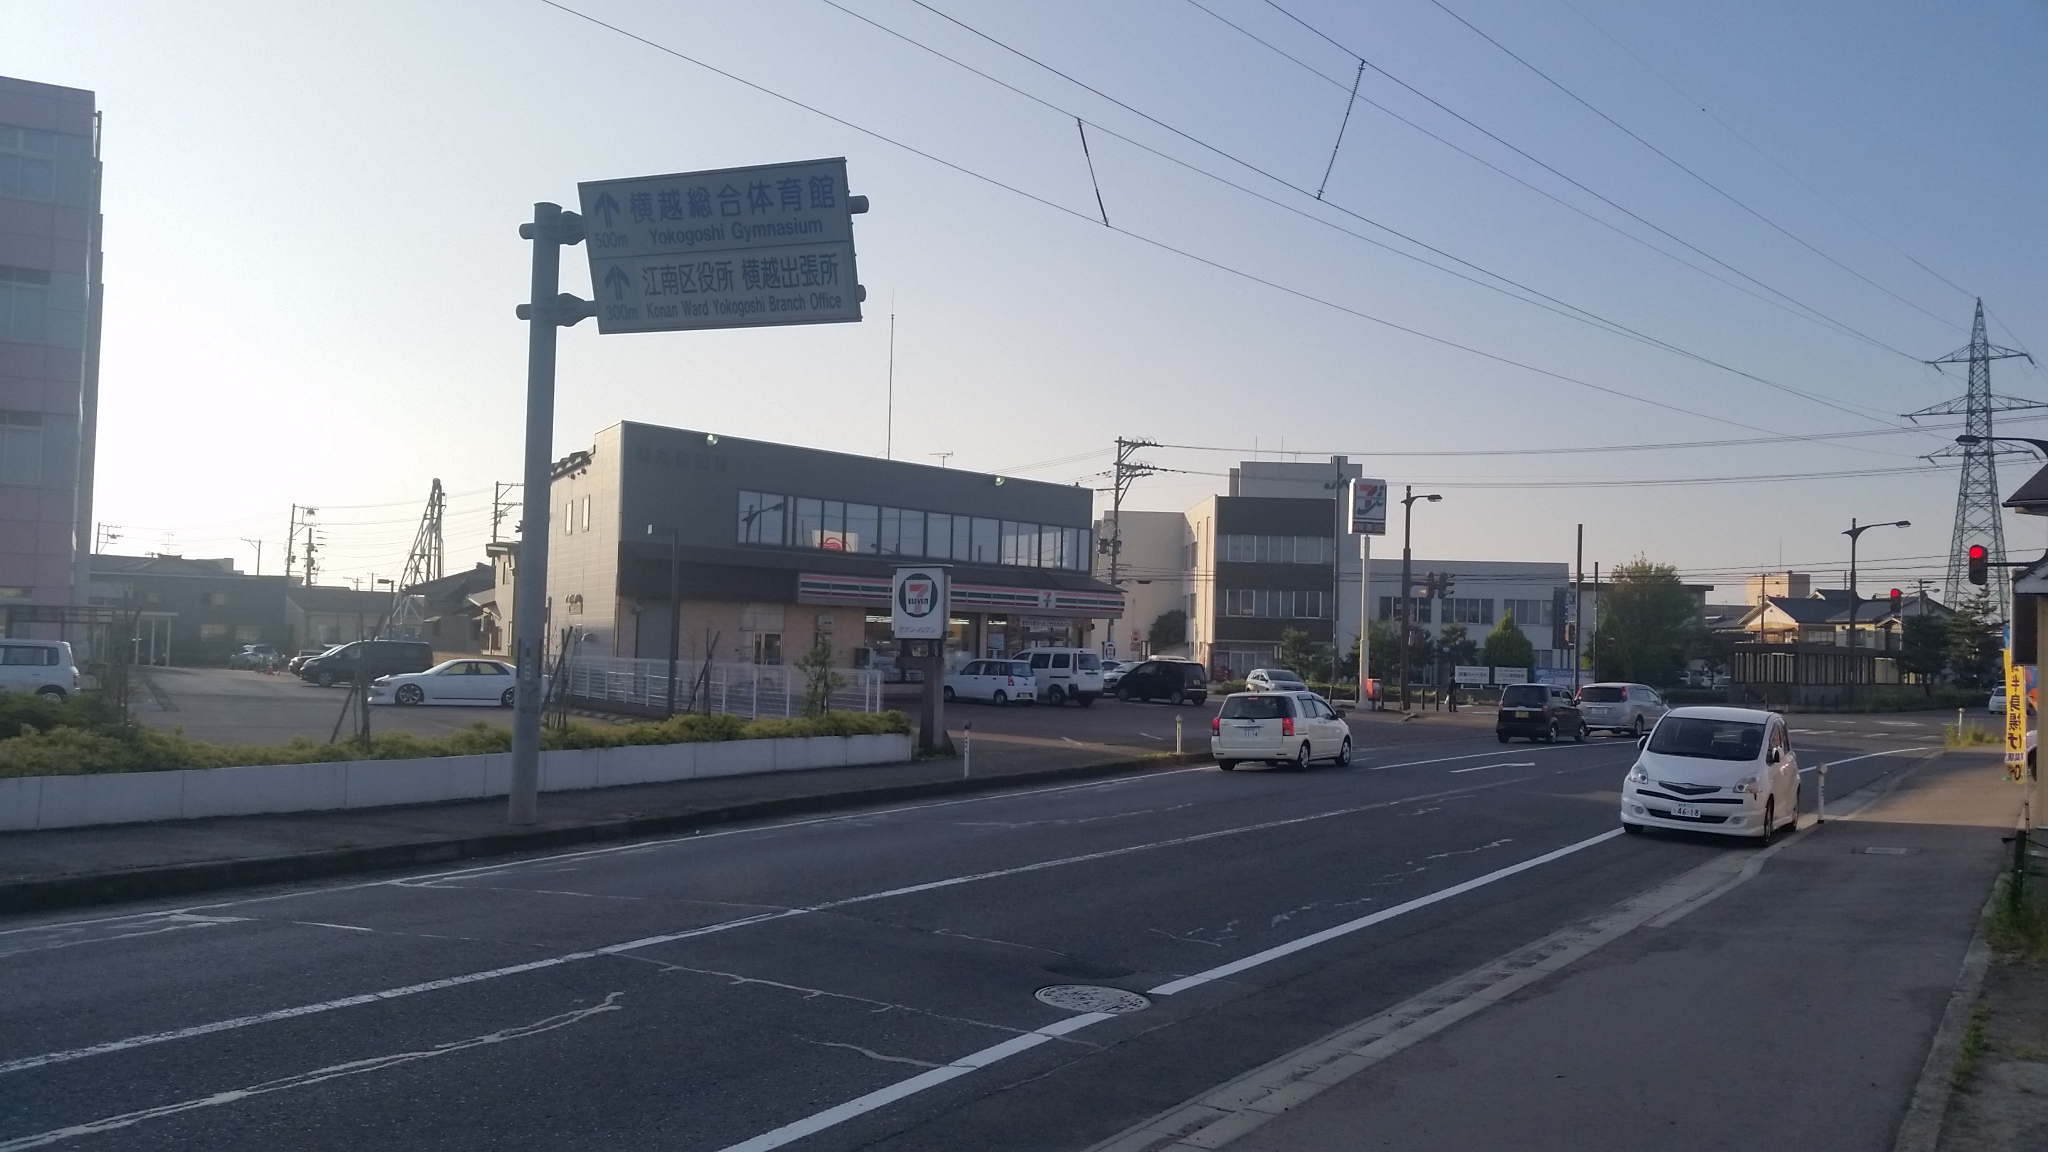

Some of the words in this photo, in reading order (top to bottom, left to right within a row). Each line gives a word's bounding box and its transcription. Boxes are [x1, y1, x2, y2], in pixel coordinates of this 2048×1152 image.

[630, 174, 836, 224] 横越総合体育館
[595, 232, 628, 249] 500m
[649, 223, 725, 246] Yokogoshi
[732, 217, 823, 242] Gymnasium
[642, 261, 734, 296] 江南区役所
[741, 253, 839, 291] 横越出張所
[605, 304, 640, 321] 300m
[646, 302, 678, 319] Konan
[681, 298, 709, 317] Ward
[712, 296, 766, 318] Yokogoshi
[768, 294, 807, 313] Branch
[810, 292, 842, 310] Office
